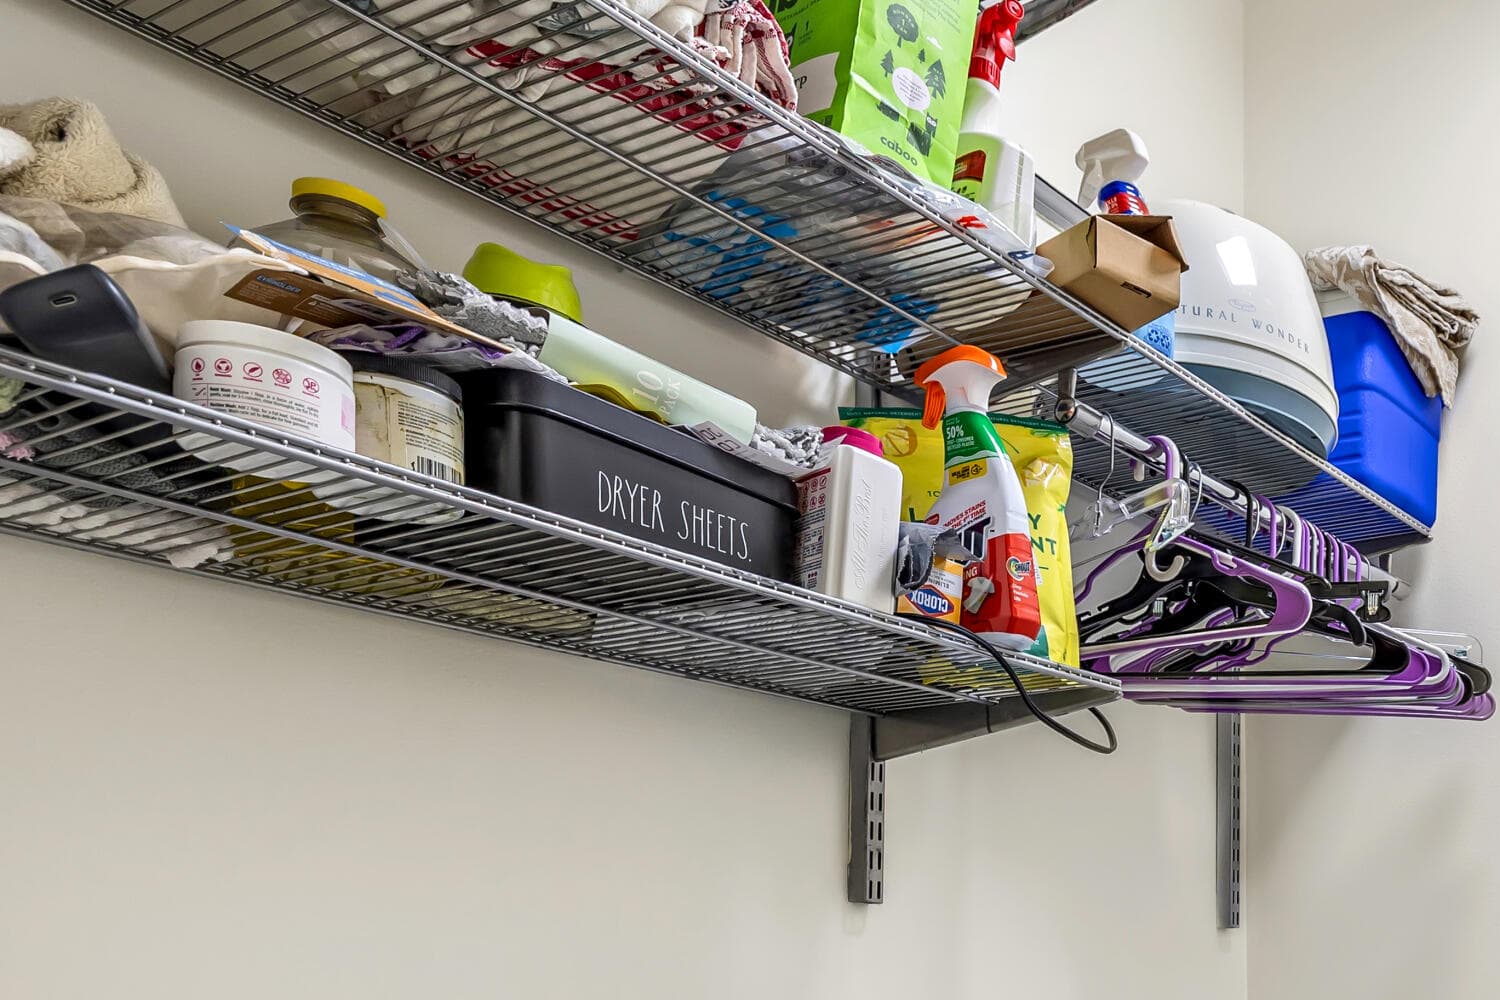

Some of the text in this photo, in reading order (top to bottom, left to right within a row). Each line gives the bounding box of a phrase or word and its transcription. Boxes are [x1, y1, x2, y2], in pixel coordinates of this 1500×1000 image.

[880, 135, 918, 167] caboo
[1176, 304, 1237, 323] TURAL
[1251, 318, 1309, 353] WONDER
[631, 369, 664, 405] 10
[658, 377, 681, 415] PACK
[946, 424, 965, 440] 50%
[598, 470, 664, 533] DRYER
[677, 500, 752, 562] SHEETS.
[943, 511, 964, 528] MOVES
[963, 500, 986, 516] STAINS
[970, 507, 987, 521] TIME
[1014, 561, 1030, 575] SHOUT
[910, 589, 949, 613] CLOROX
